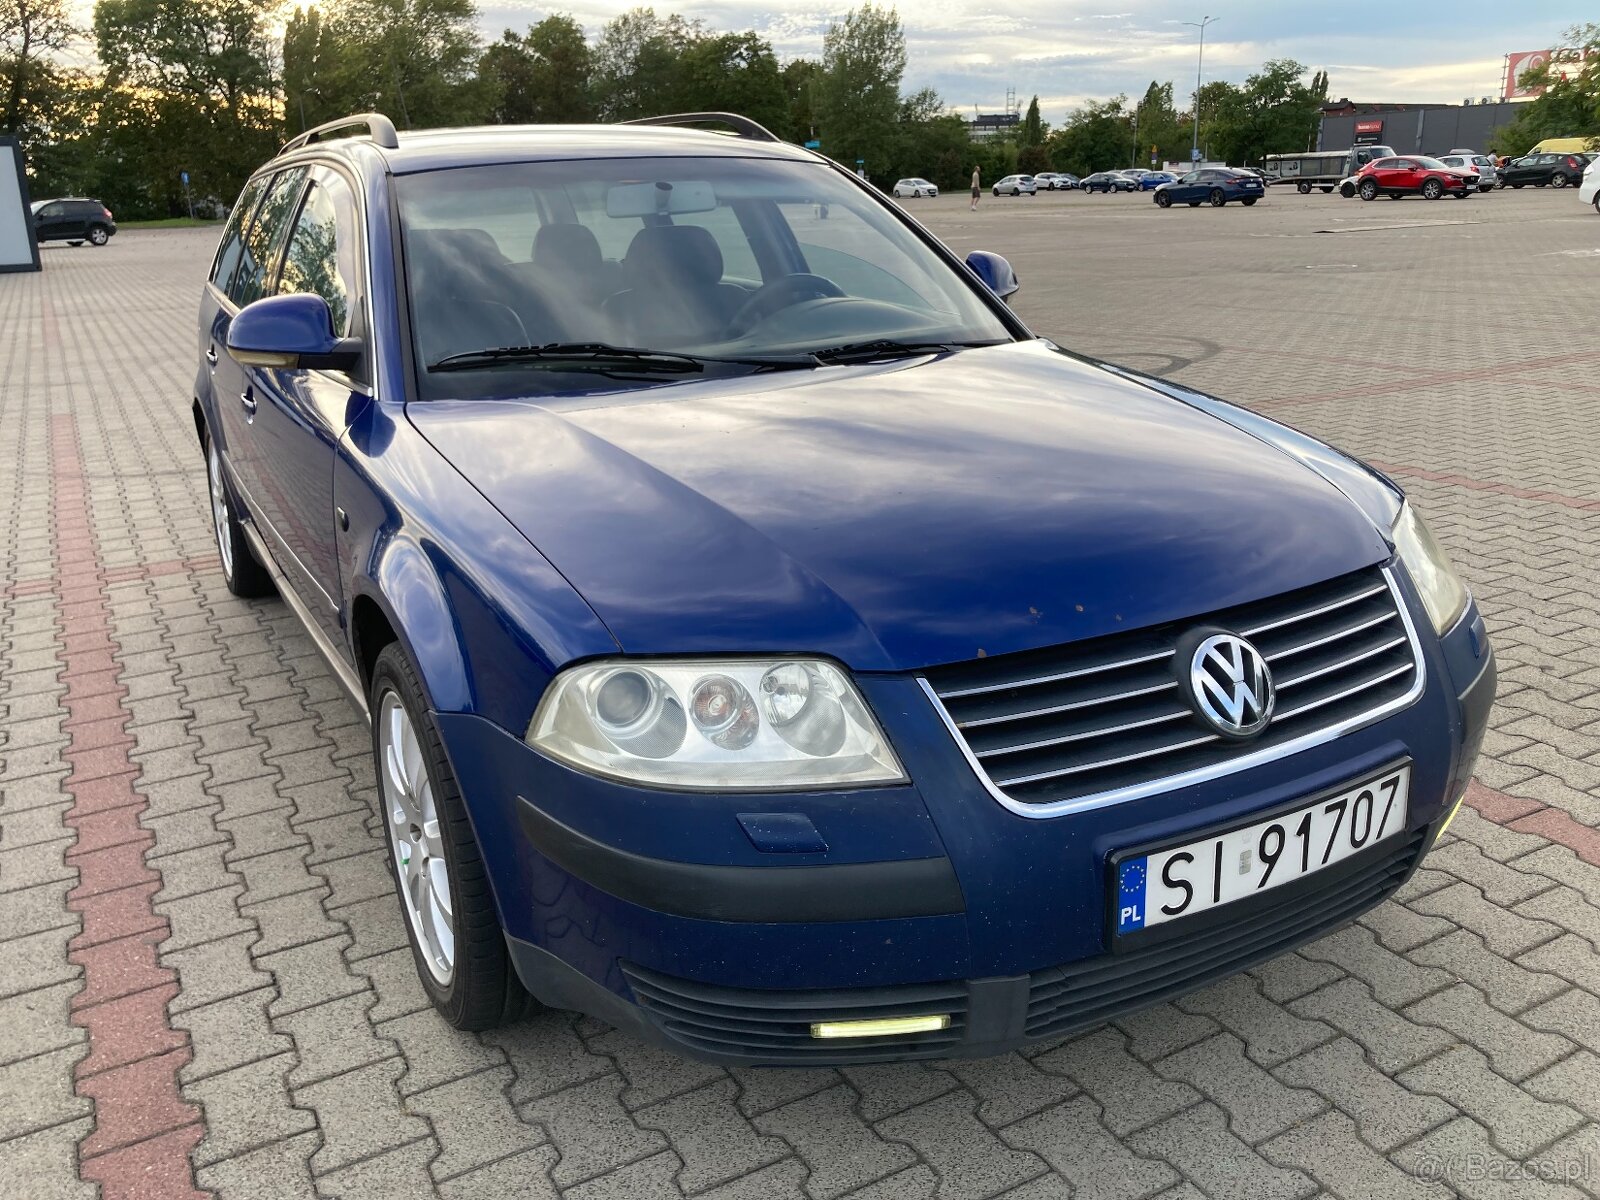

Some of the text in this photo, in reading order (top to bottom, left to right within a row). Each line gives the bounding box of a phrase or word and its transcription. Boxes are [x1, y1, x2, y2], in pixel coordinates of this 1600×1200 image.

[1160, 774, 1401, 916] SI 91707
[1120, 904, 1142, 926] PL
